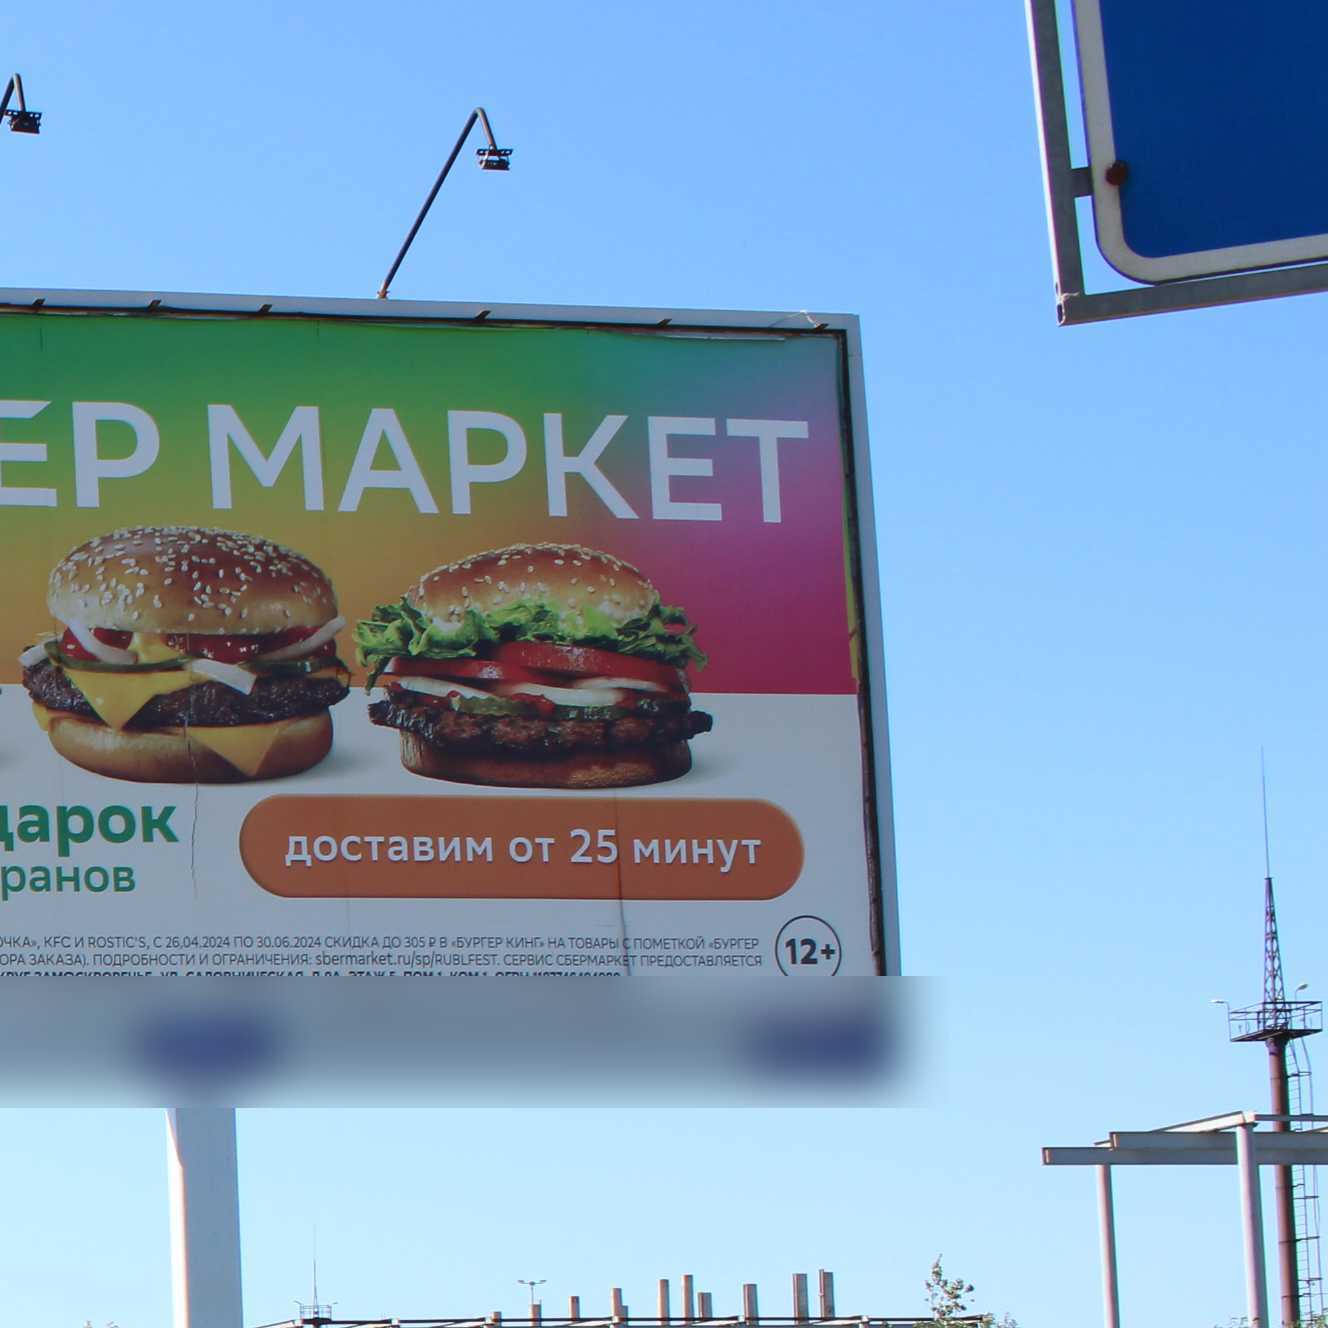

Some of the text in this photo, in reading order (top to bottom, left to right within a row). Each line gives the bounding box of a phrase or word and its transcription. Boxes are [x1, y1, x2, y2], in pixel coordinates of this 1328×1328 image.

[207, 404, 809, 523] МАРКЕТ
[284, 829, 762, 873] доставим от 25 минут
[44, 935, 72, 949] KFC
[75, 935, 85, 949] И
[234, 935, 254, 949] ПО
[257, 935, 322, 949] 30.06.2024
[325, 935, 379, 951] СКИДКА
[382, 935, 401, 951] ДО
[404, 935, 425, 949] 305
[439, 935, 448, 949] В
[547, 937, 565, 949] НА
[568, 937, 619, 949] ТОВАРЫ
[633, 935, 705, 950] ПОМЕТКОЙ
[785, 938, 836, 965] 12+
[93, 953, 195, 968] ПОДРОБНОСТИ
[199, 953, 209, 967] И
[503, 954, 552, 967] СЕРВИС
[557, 954, 637, 968] СБЕРМАРКЕТ
[640, 955, 762, 969] ПРЕДОСТАВЛЯЕТСЯ
